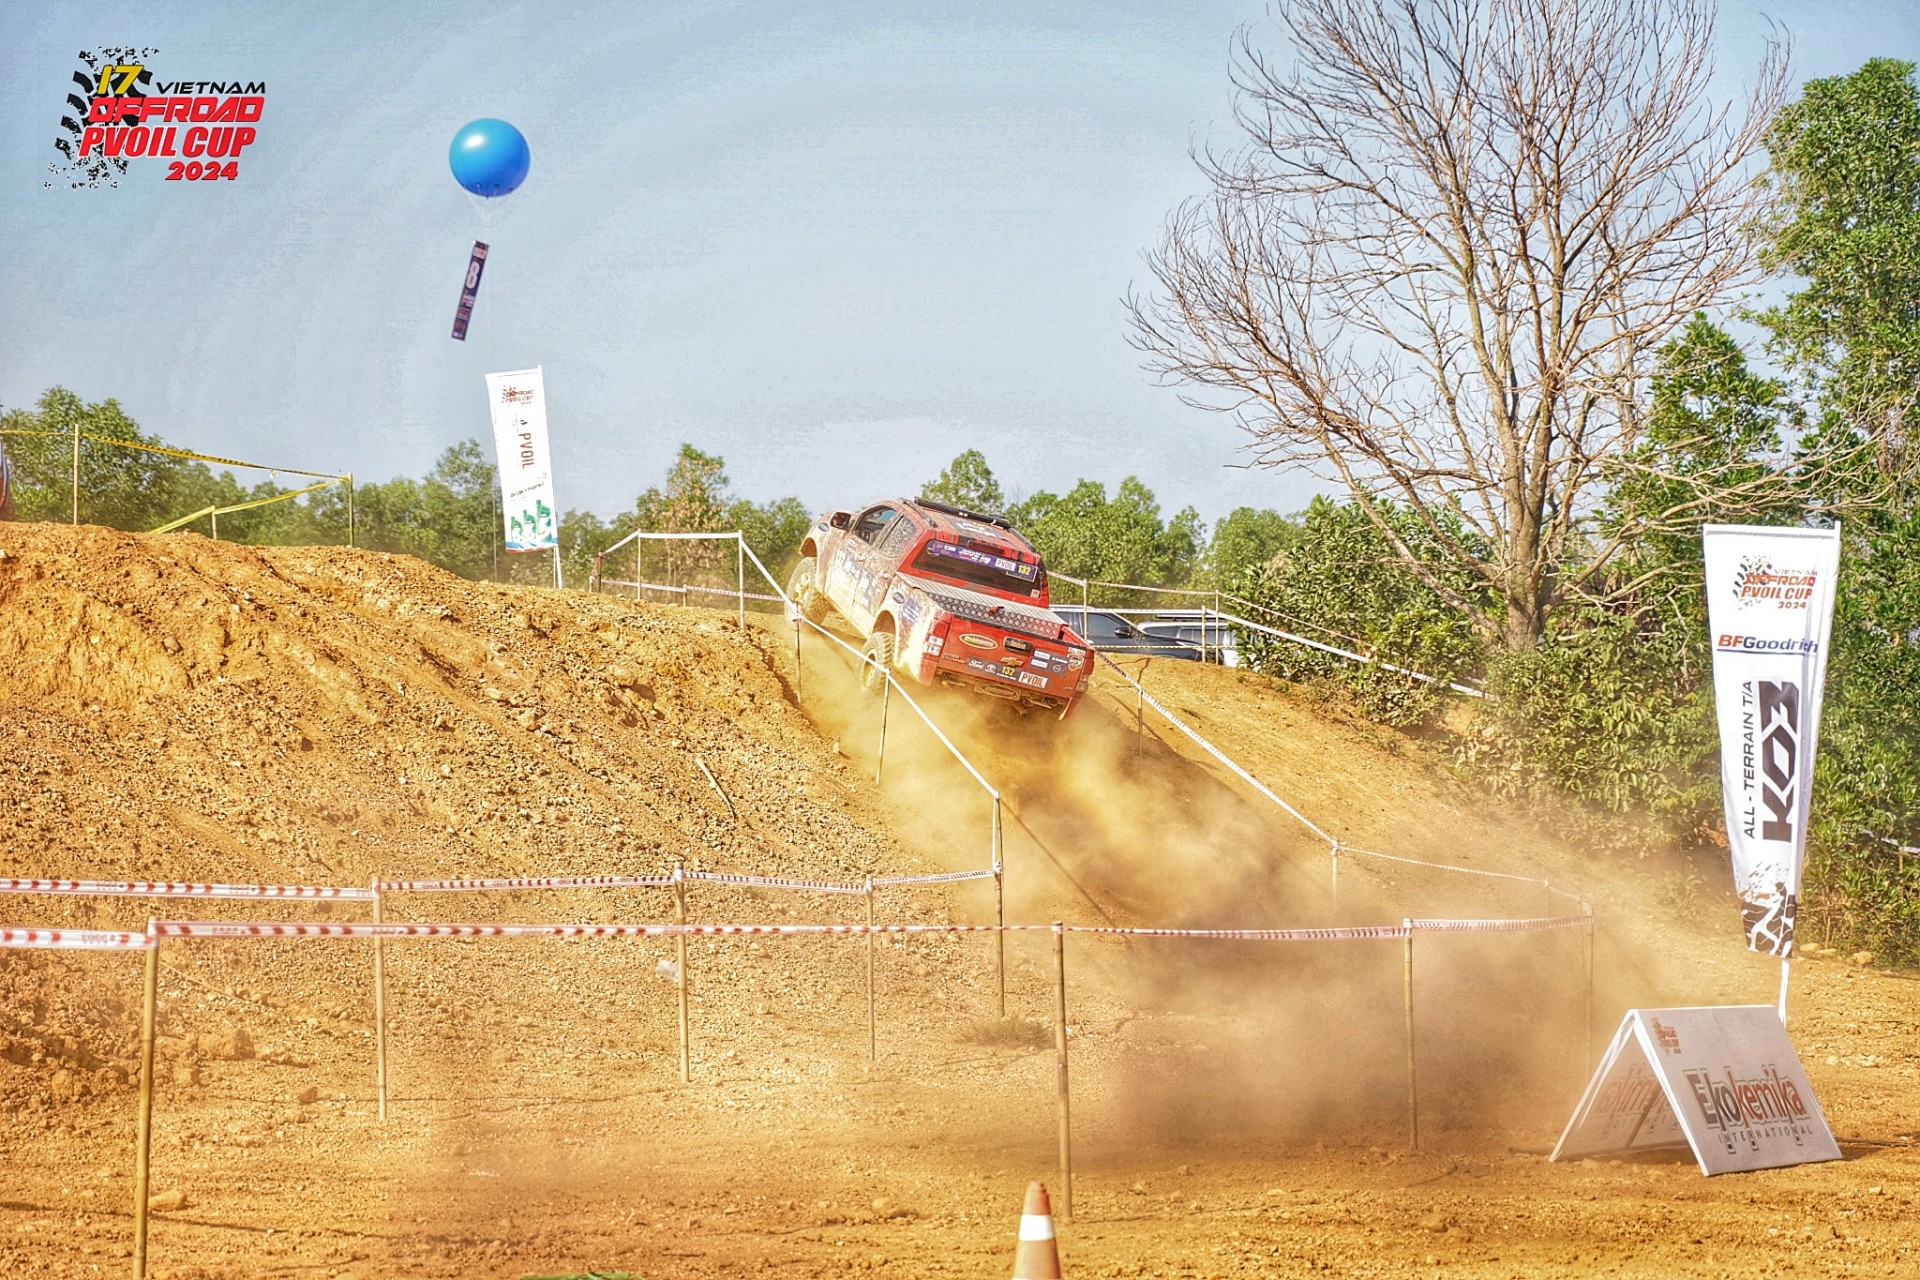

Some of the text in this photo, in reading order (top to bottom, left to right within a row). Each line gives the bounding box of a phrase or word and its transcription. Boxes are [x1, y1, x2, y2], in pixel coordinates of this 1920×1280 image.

[518, 432, 535, 470] PVOIL
[1018, 564, 1031, 575] 132
[1745, 574, 1817, 587] OFFROAD
[1741, 585, 1813, 600] PVOIL CUP
[1777, 601, 1807, 610] 2024
[1002, 666, 1016, 676] 132
[1021, 672, 1044, 687] PVOIL
[1741, 681, 1754, 707] T/A
[1743, 711, 1755, 791] TERRAIN
[1743, 806, 1755, 840] ALL
[1683, 1065, 1810, 1133] Ekokemika
[1718, 1124, 1813, 1144] INTERNATIONAL
